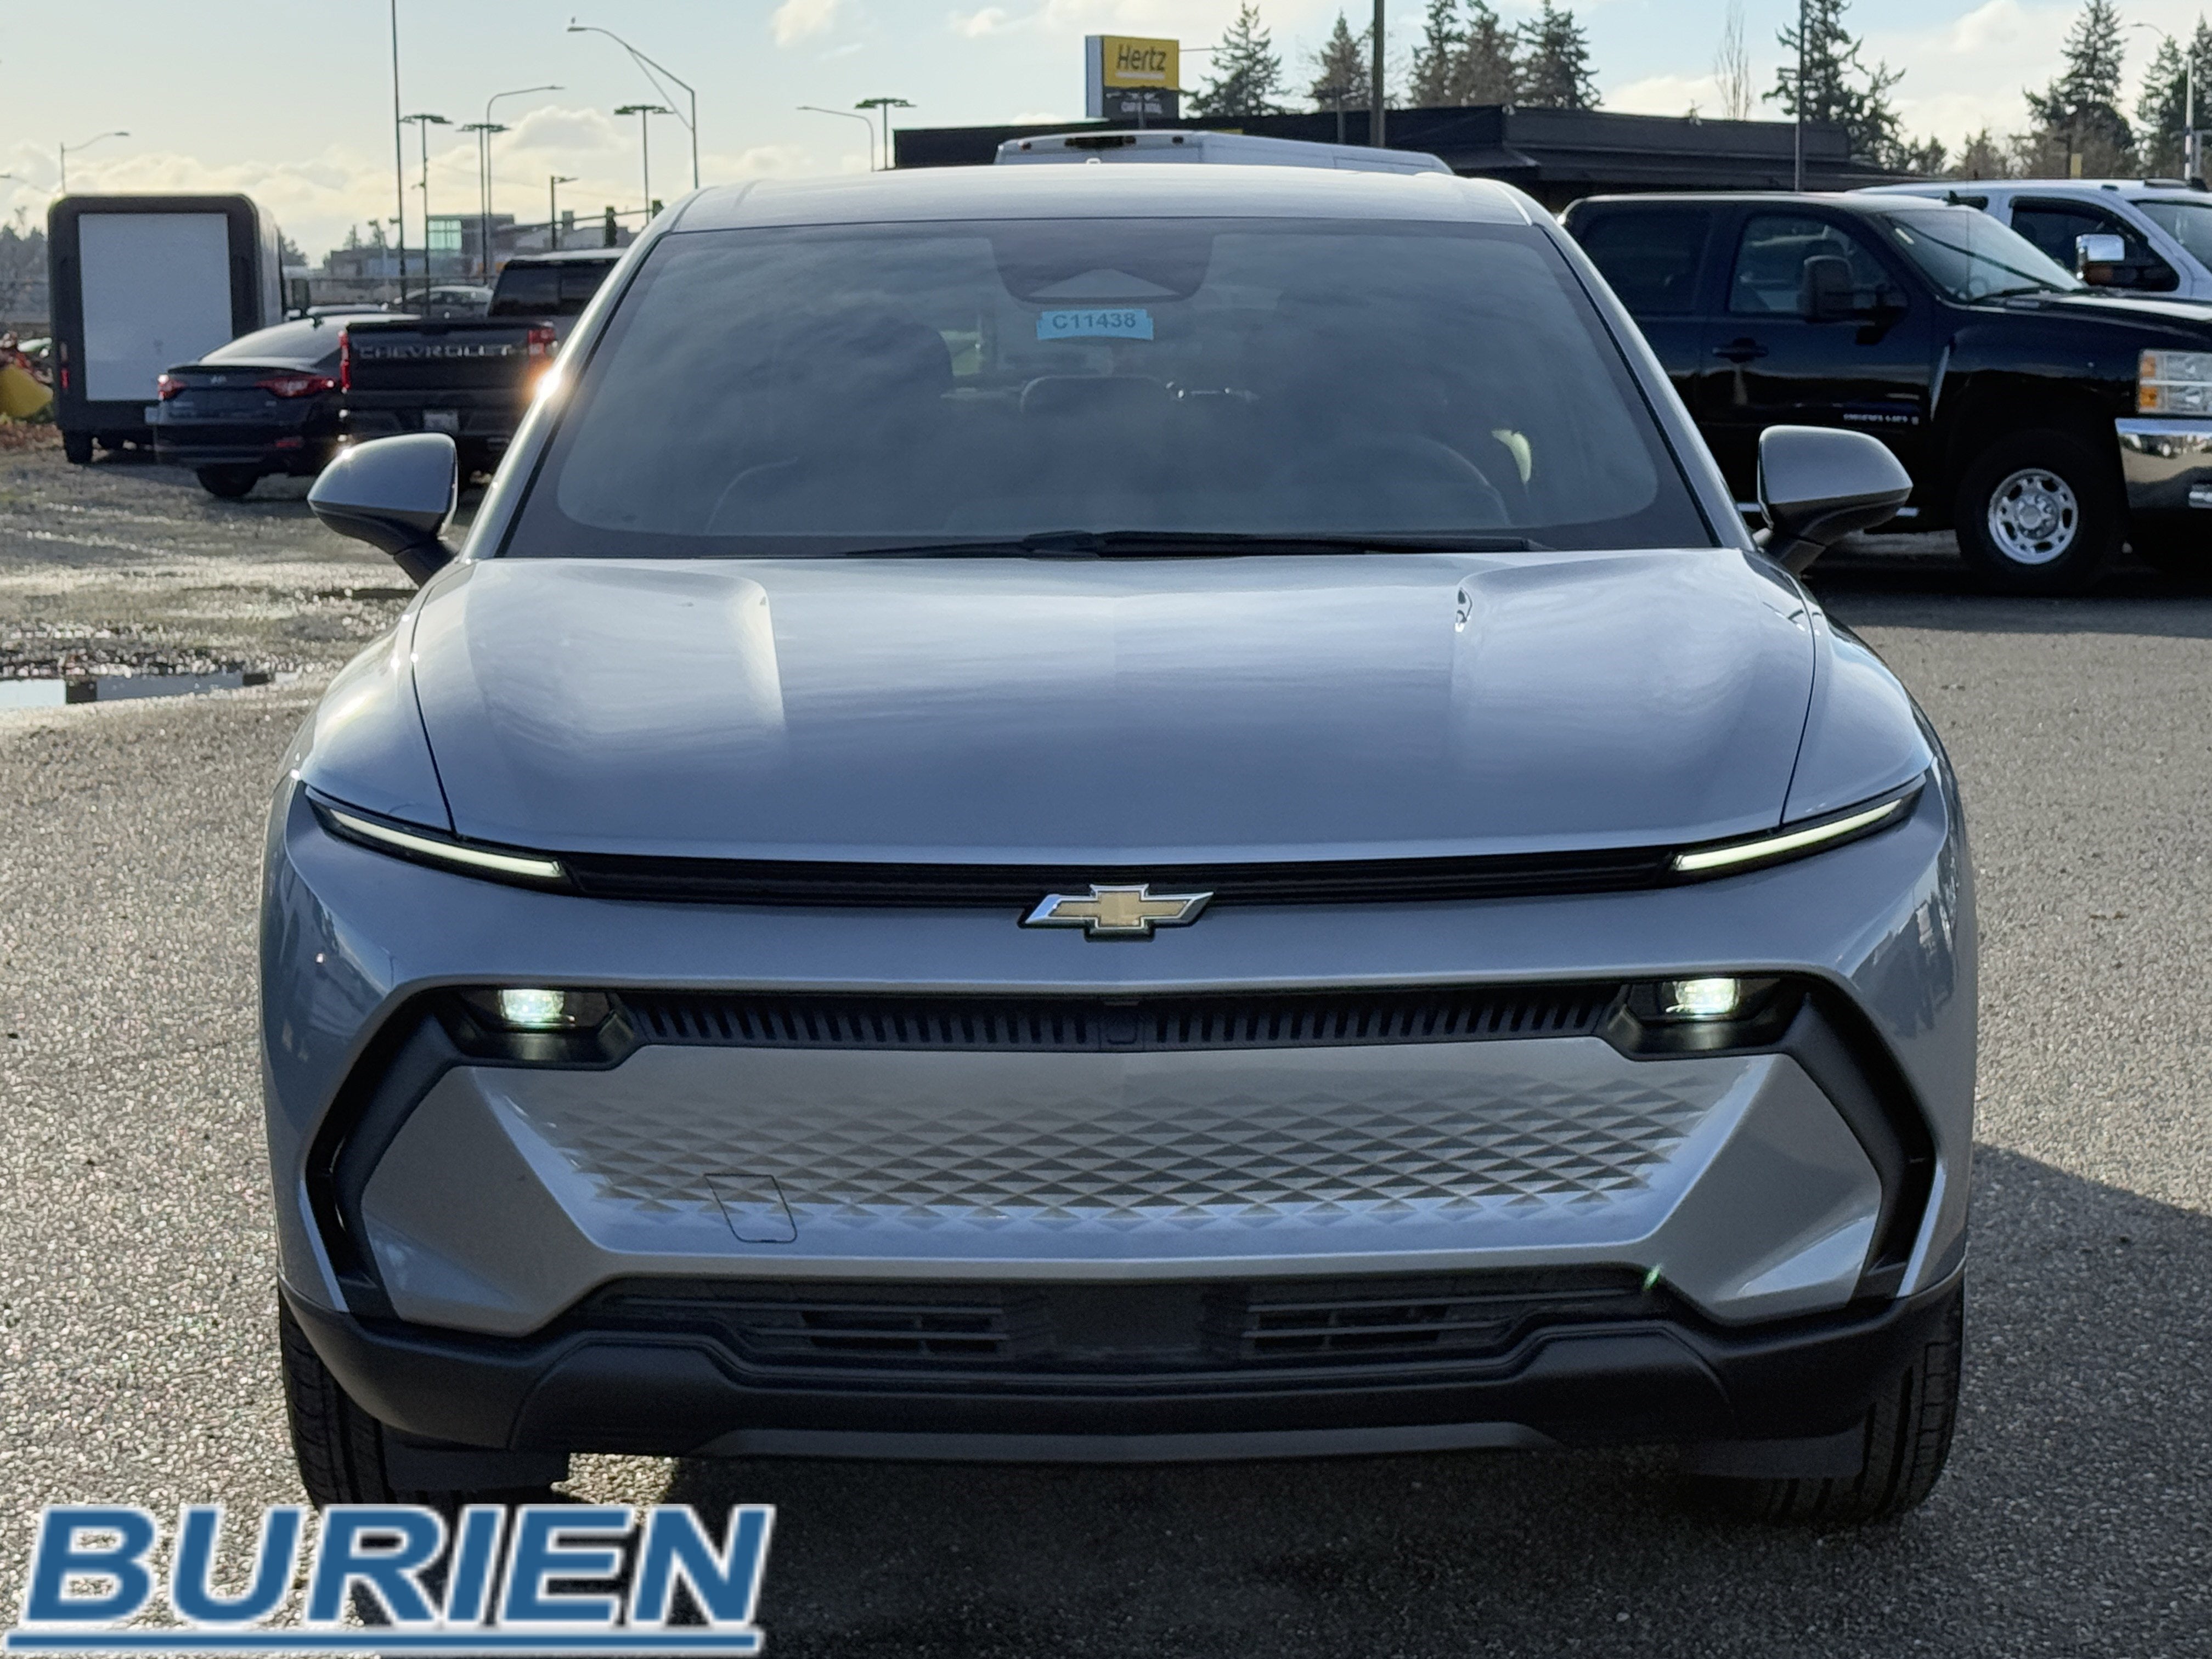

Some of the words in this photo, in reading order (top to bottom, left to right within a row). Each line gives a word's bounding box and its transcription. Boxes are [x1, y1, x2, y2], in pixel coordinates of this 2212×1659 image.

[1116, 43, 1167, 72] Hertz
[1052, 312, 1137, 329] C11438
[359, 343, 514, 359] CHEVROLET
